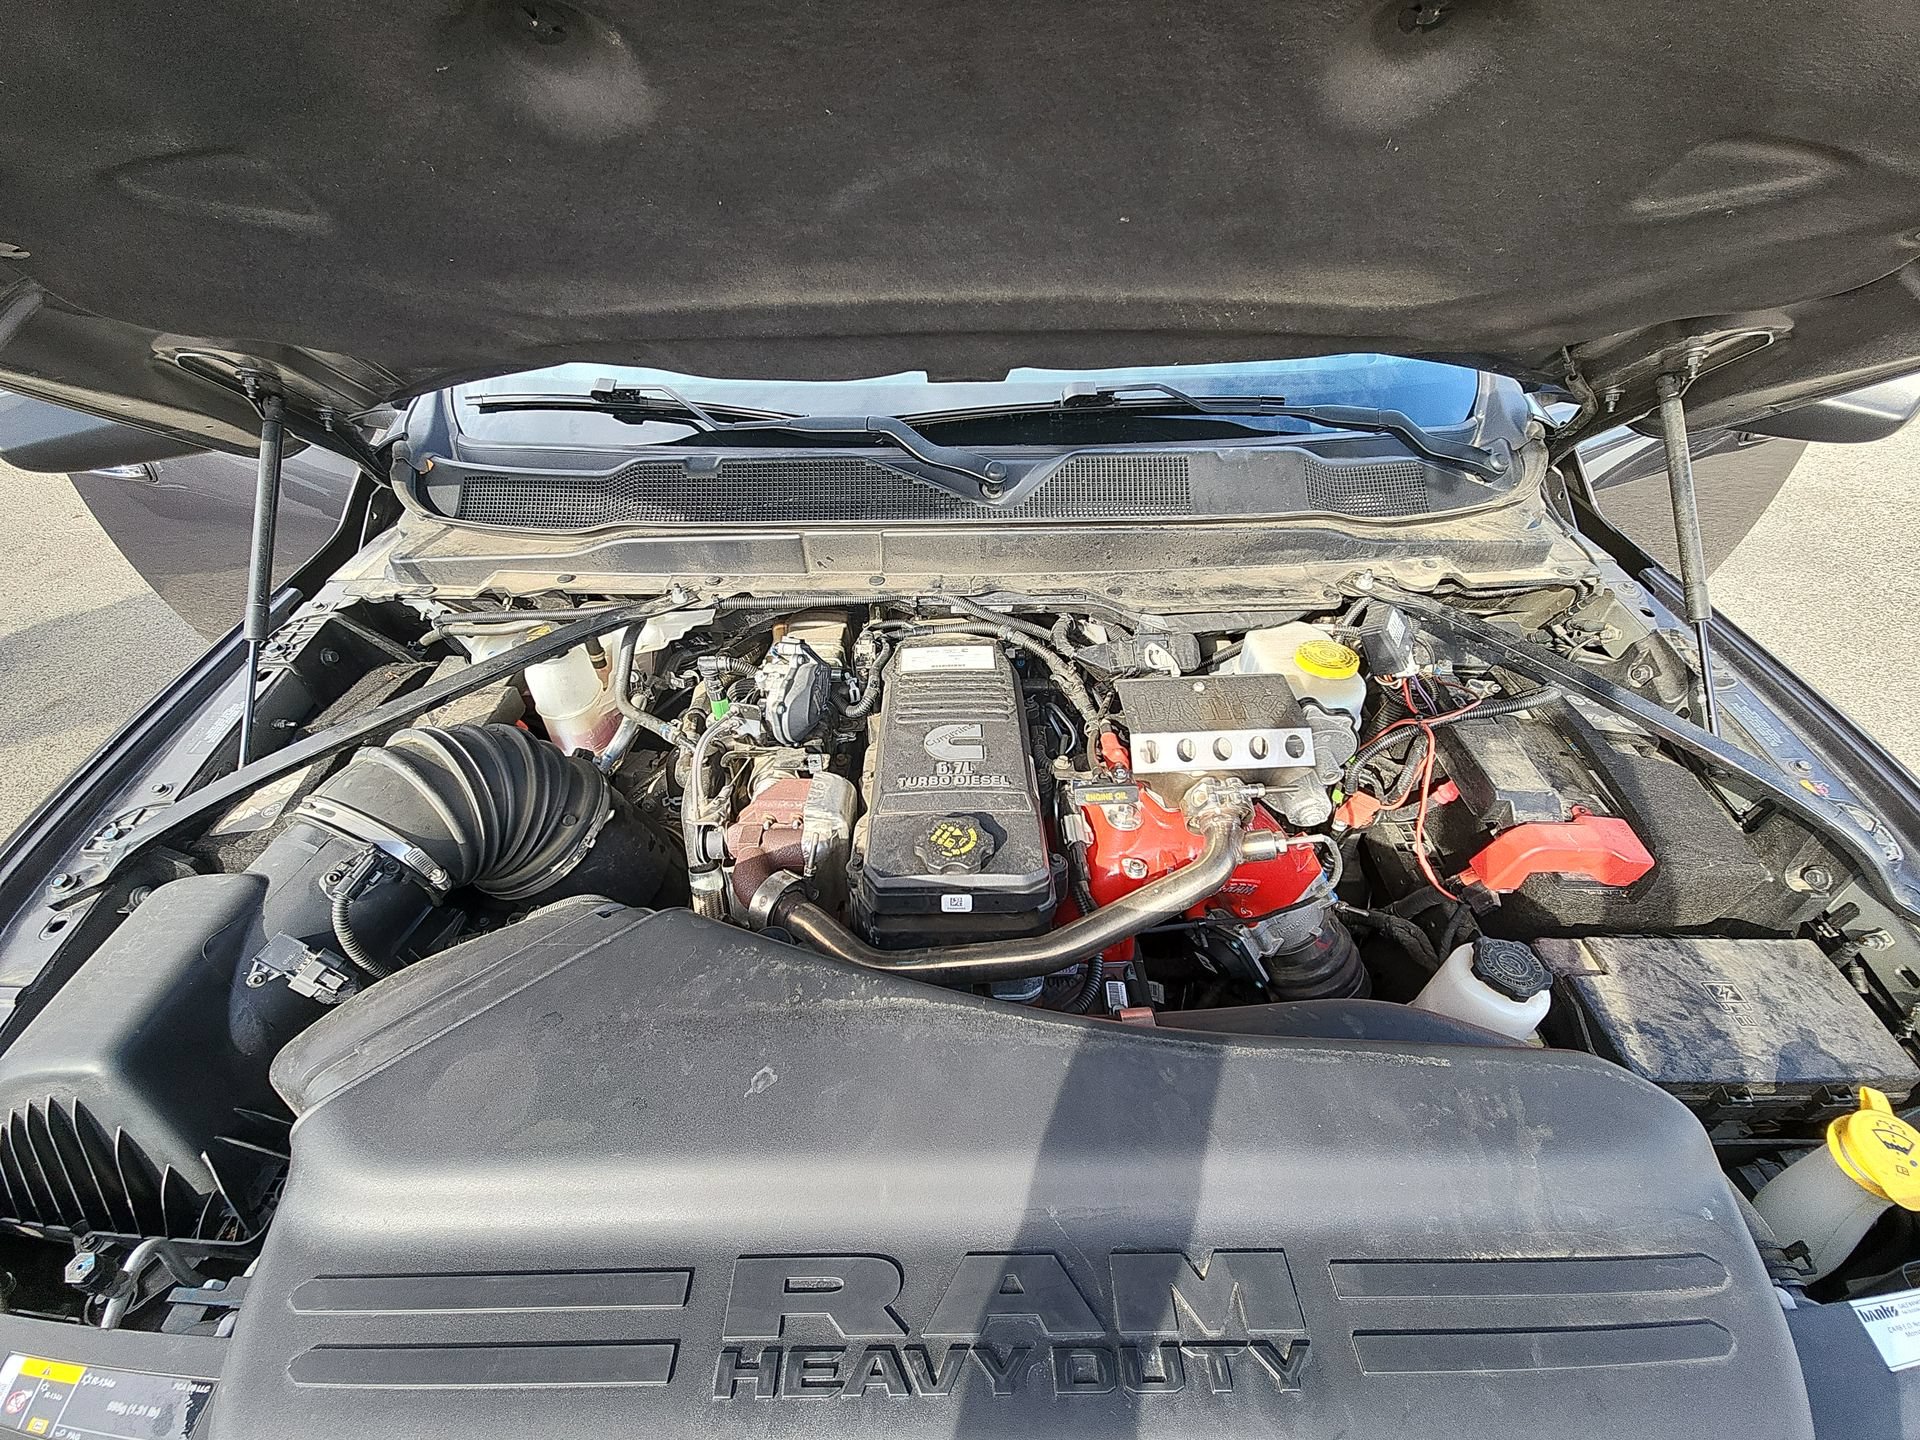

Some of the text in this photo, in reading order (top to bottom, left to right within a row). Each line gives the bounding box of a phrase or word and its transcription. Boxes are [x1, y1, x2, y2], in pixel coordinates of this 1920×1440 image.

[925, 723, 976, 746] Cummins
[936, 761, 975, 775] 6.7L
[897, 775, 1011, 787] TURBO DIESEL
[1085, 791, 1128, 801] ENGINE OIL
[722, 1249, 1306, 1339] RAM
[713, 1340, 1310, 1400] HEAVY DUTY
